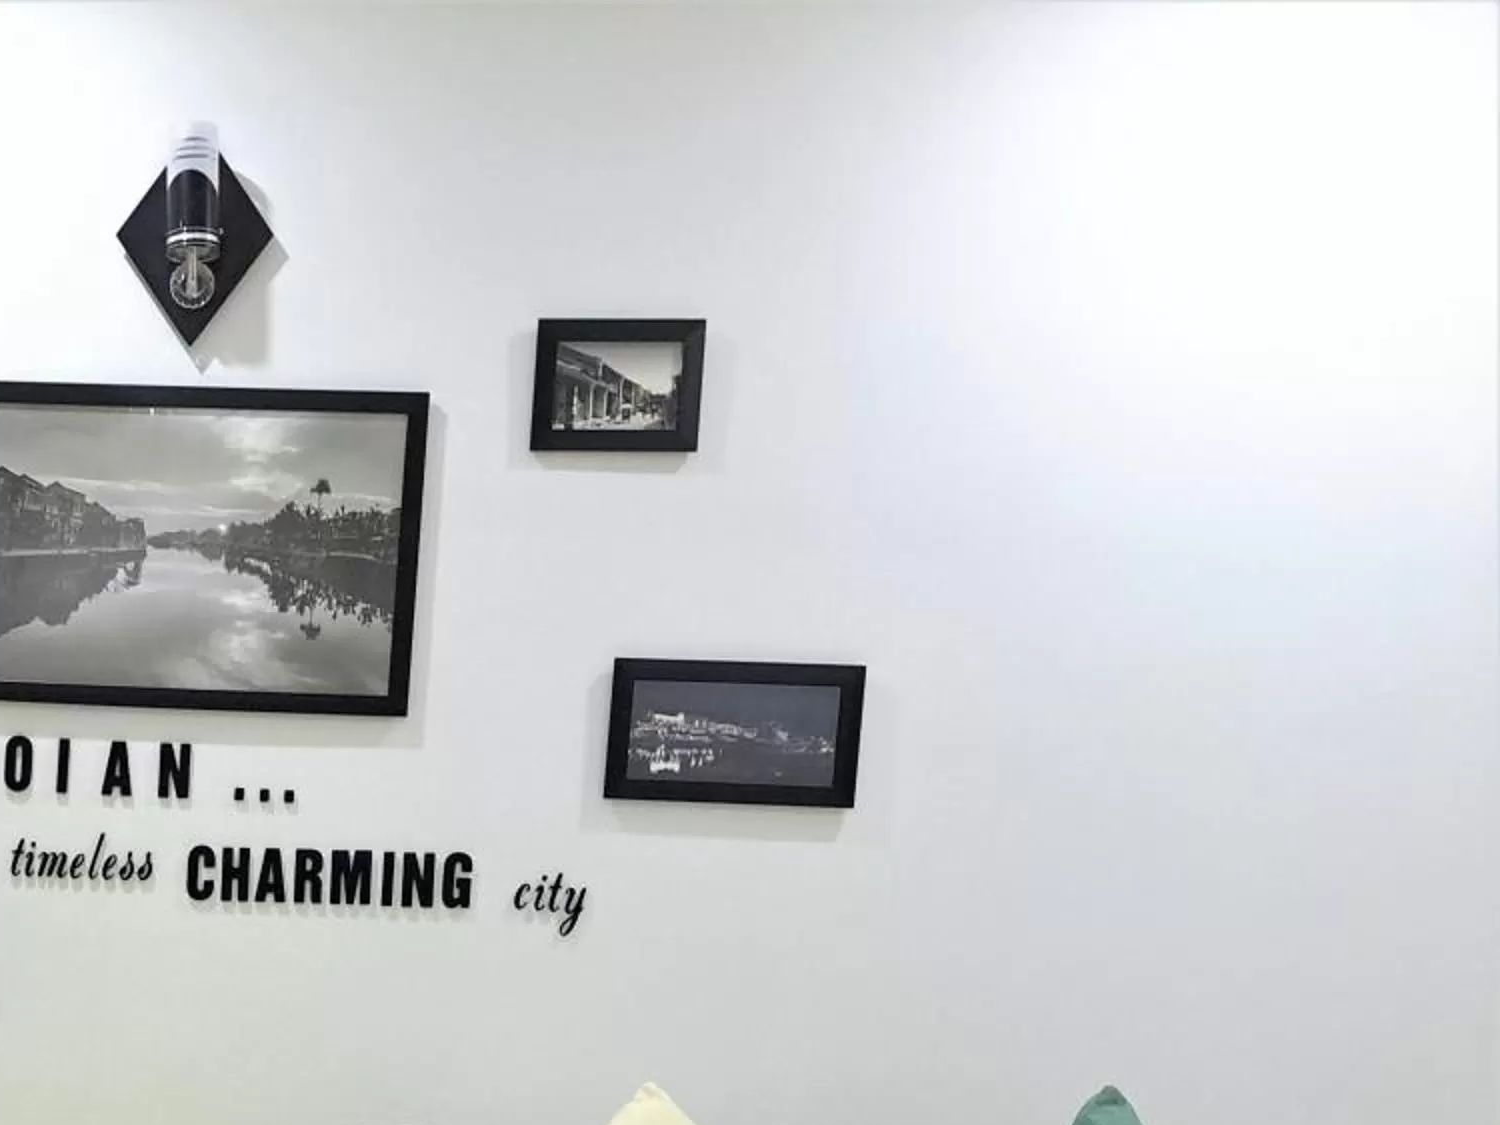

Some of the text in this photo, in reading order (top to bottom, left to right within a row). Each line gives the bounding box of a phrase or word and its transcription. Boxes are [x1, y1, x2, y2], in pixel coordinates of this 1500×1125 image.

[10, 832, 587, 937] timeless CHARMING city
